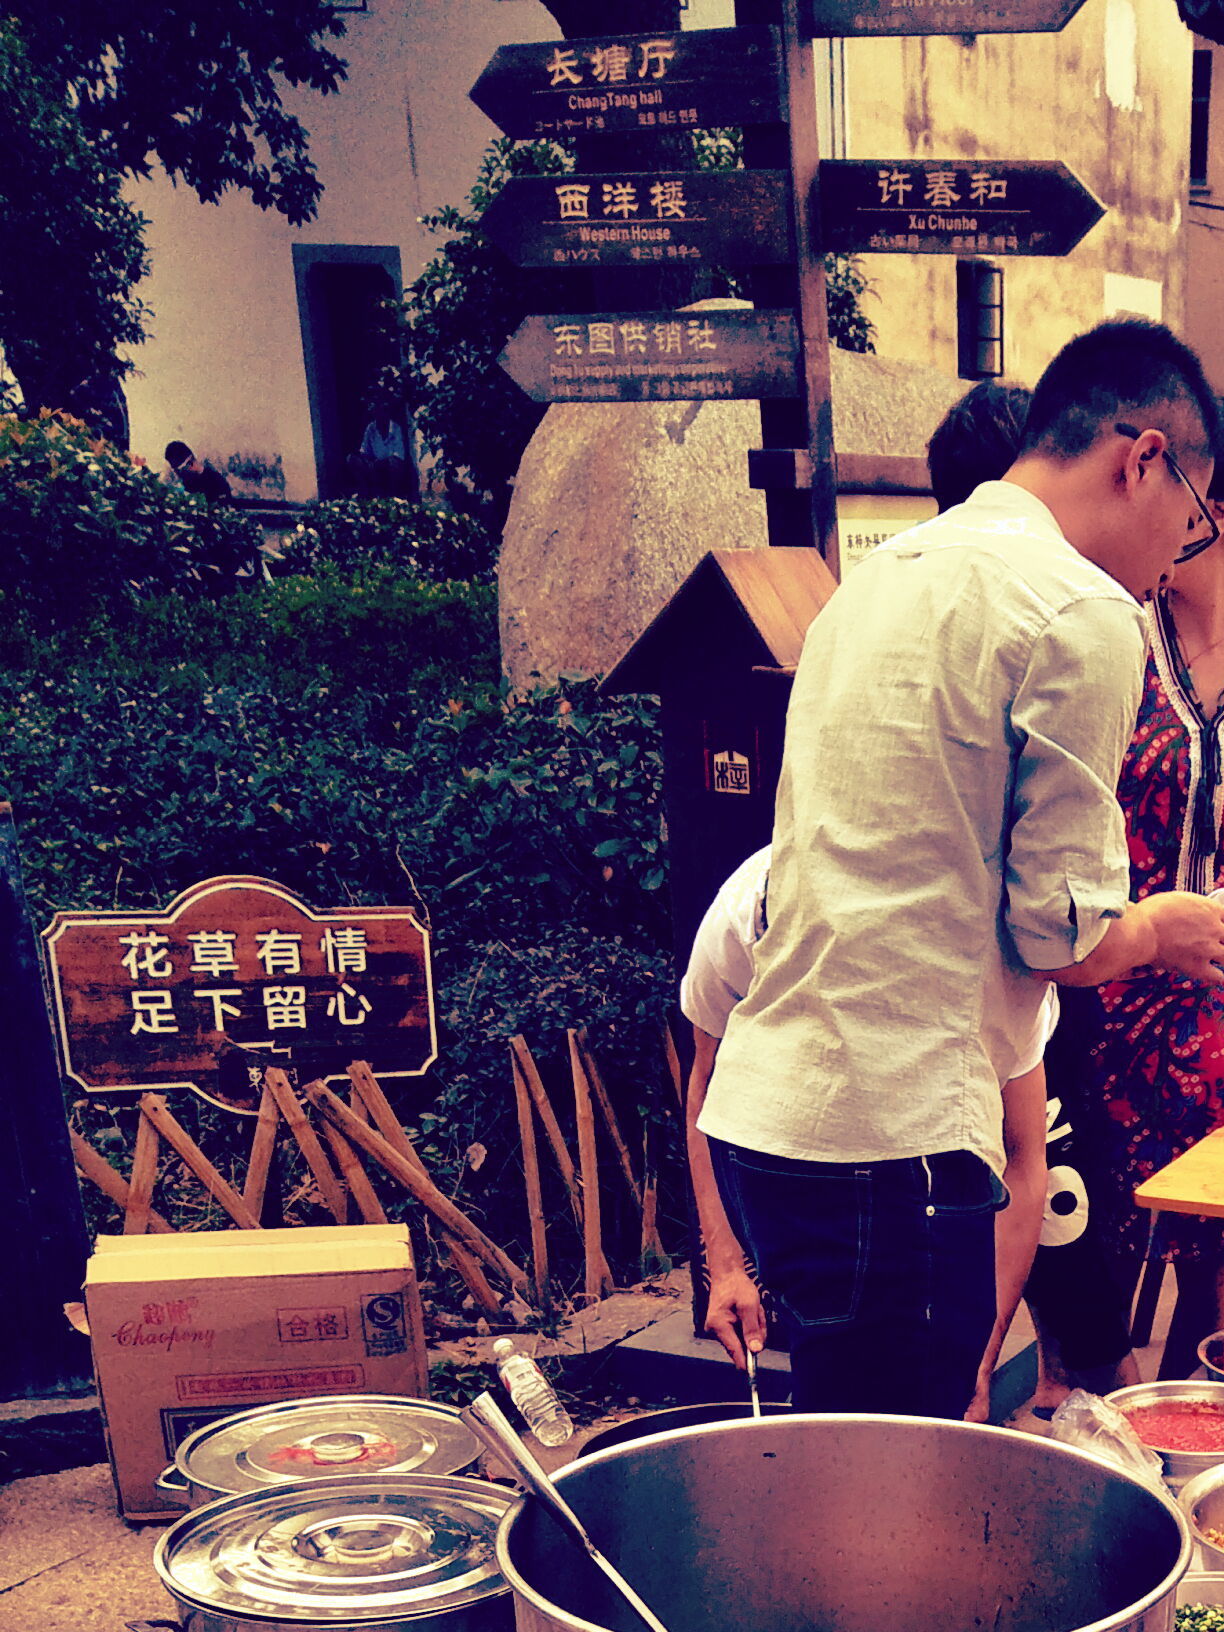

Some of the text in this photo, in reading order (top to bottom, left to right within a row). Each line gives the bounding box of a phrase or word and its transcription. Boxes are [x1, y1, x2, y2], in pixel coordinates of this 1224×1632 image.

[547, 39, 676, 85] 长塘厅
[640, 89, 662, 105] hall
[555, 181, 686, 219] 西洋楼
[878, 169, 1008, 206] 许春和
[579, 226, 670, 243] Western House
[909, 215, 977, 231] Xu Chunhe
[554, 319, 716, 355] 东图供销社
[119, 927, 368, 979] 花草有情
[130, 983, 372, 1035] 足下留心
[285, 1313, 340, 1338] 合格
